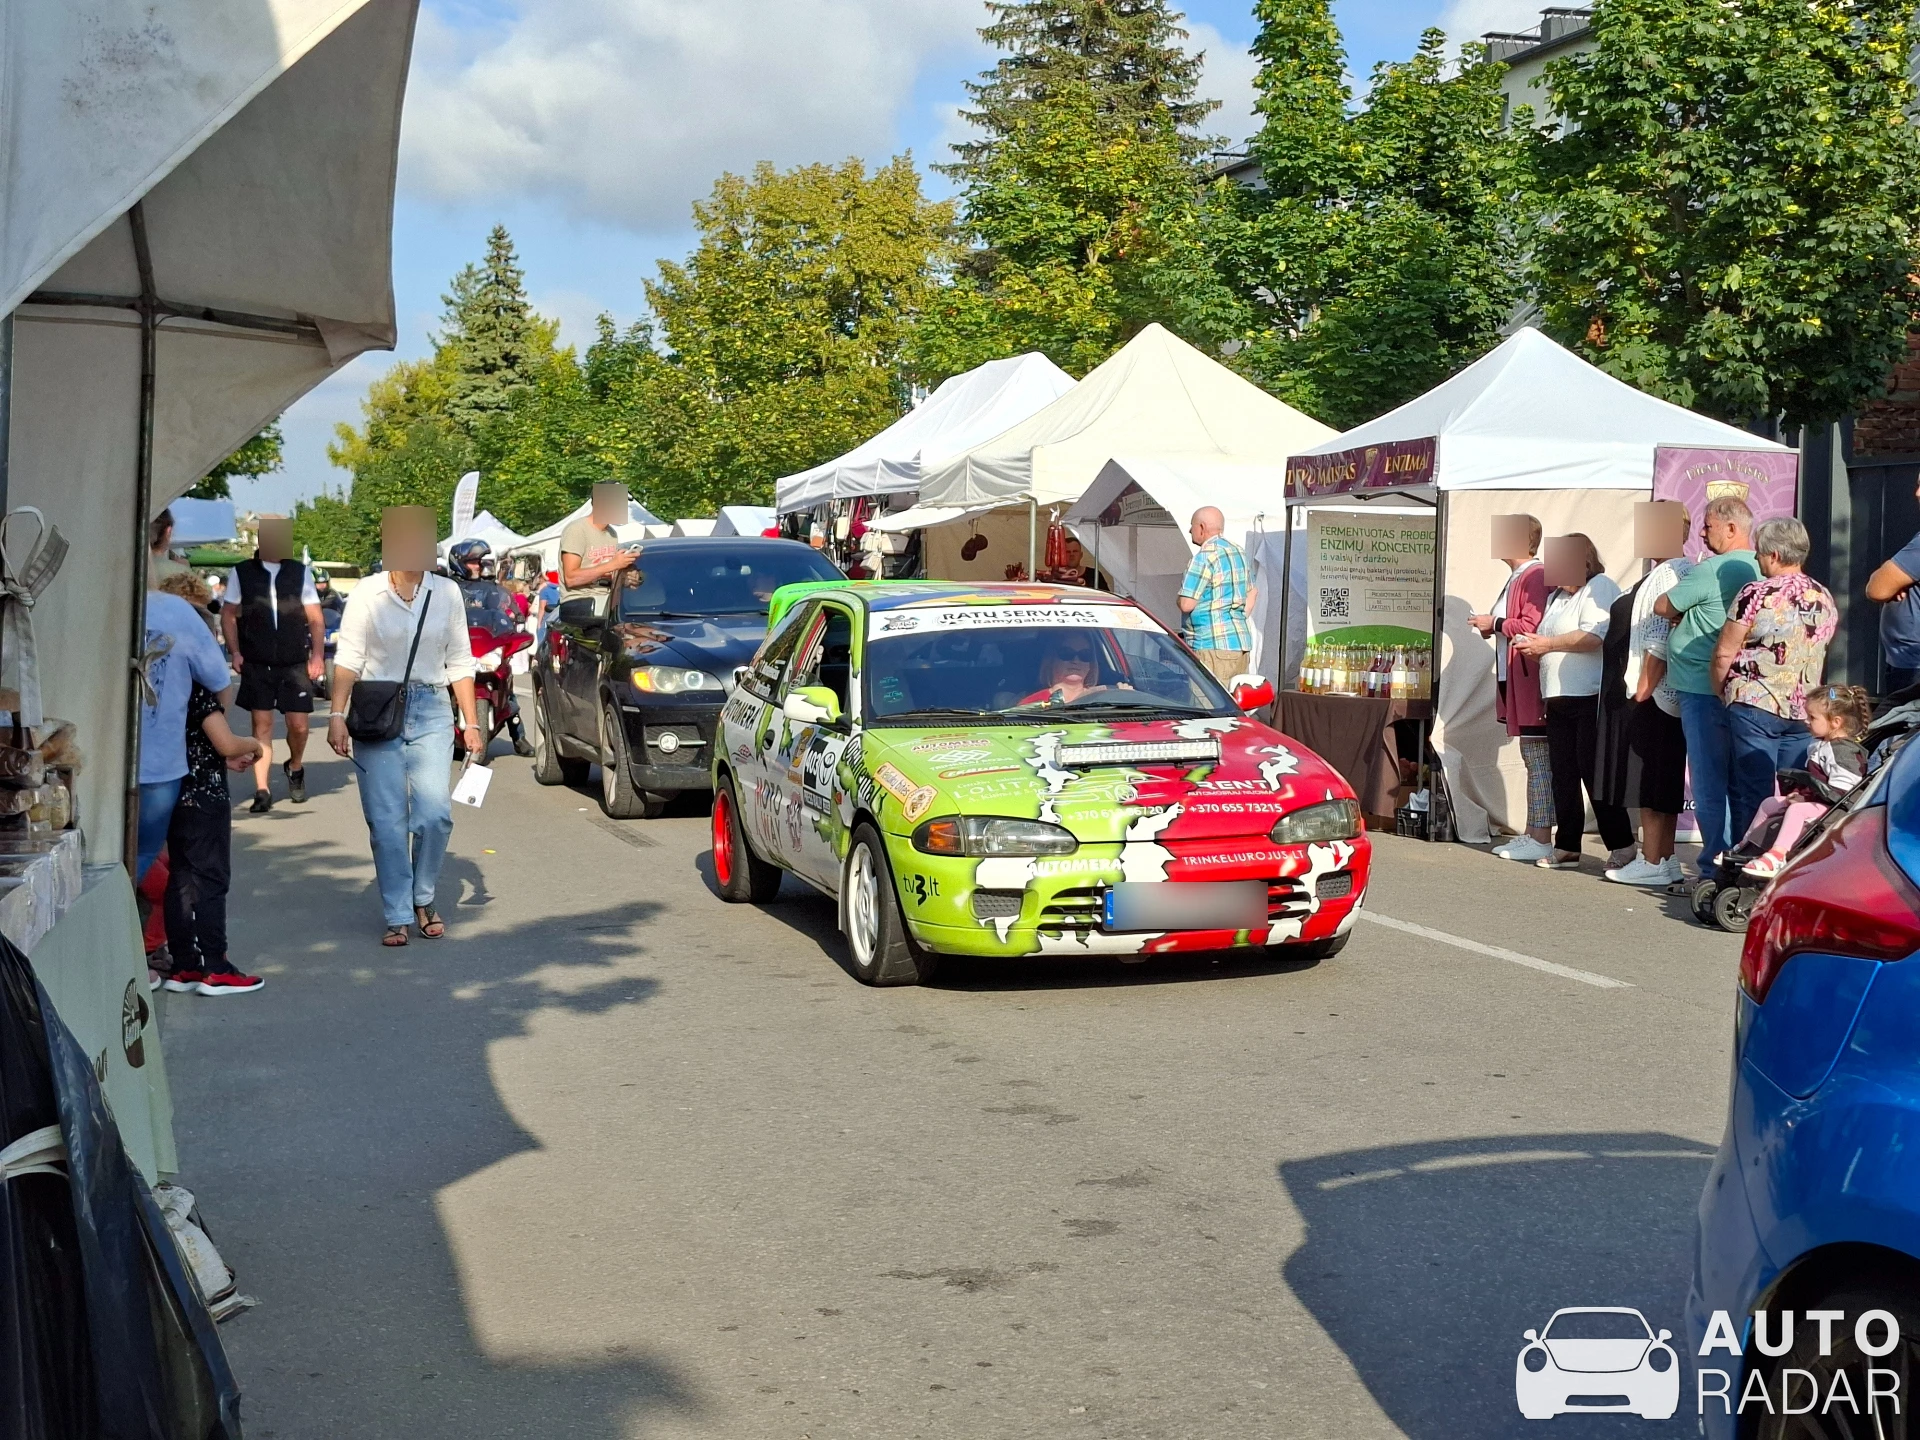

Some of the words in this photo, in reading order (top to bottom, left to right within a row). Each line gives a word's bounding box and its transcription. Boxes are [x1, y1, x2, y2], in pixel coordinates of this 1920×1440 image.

[1384, 453, 1431, 474] ENZIMAI
[1320, 525, 1395, 539] FERMENTUOTAS
[1320, 538, 1365, 554] ENZIMŲ
[1362, 554, 1399, 565] daržovių
[942, 610, 998, 621] RATŲ
[1002, 609, 1096, 618] SERVISAS
[972, 617, 1053, 626] Ramygalos
[952, 780, 1042, 800] LOLITA
[1196, 780, 1269, 791] RENT
[1188, 804, 1221, 814] +370
[1221, 803, 1244, 813] 655
[1244, 803, 1283, 813] 73215
[1028, 858, 1124, 876] AUTOMERA
[903, 873, 941, 907] tv3.lt
